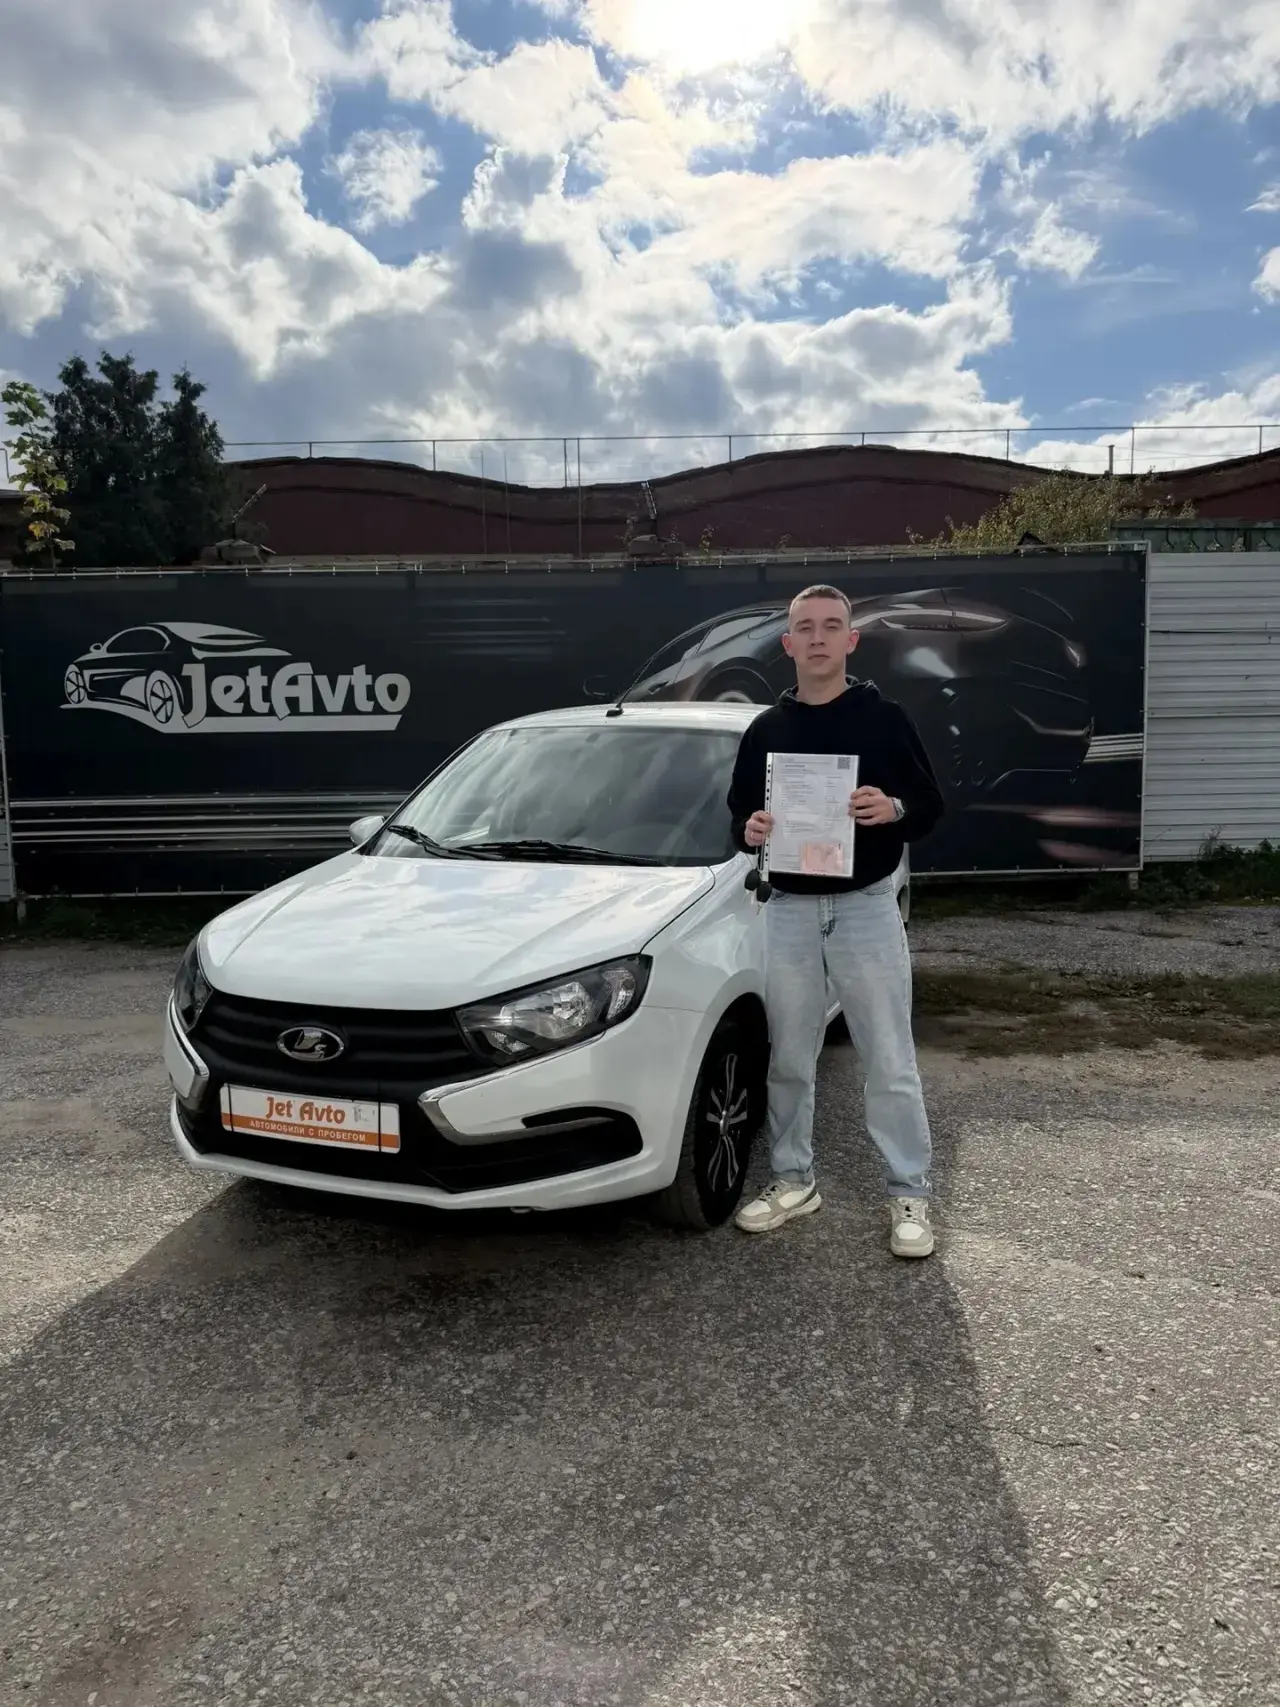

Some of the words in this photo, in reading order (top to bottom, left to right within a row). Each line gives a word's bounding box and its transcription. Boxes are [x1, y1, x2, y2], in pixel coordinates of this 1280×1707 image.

[181, 662, 411, 728] JetAvto
[266, 1096, 293, 1119] Jet
[299, 1101, 346, 1125] Avto
[250, 1120, 305, 1135] АВТОМОБИЛИ
[318, 1130, 366, 1142] ПРОБЕГОМ
